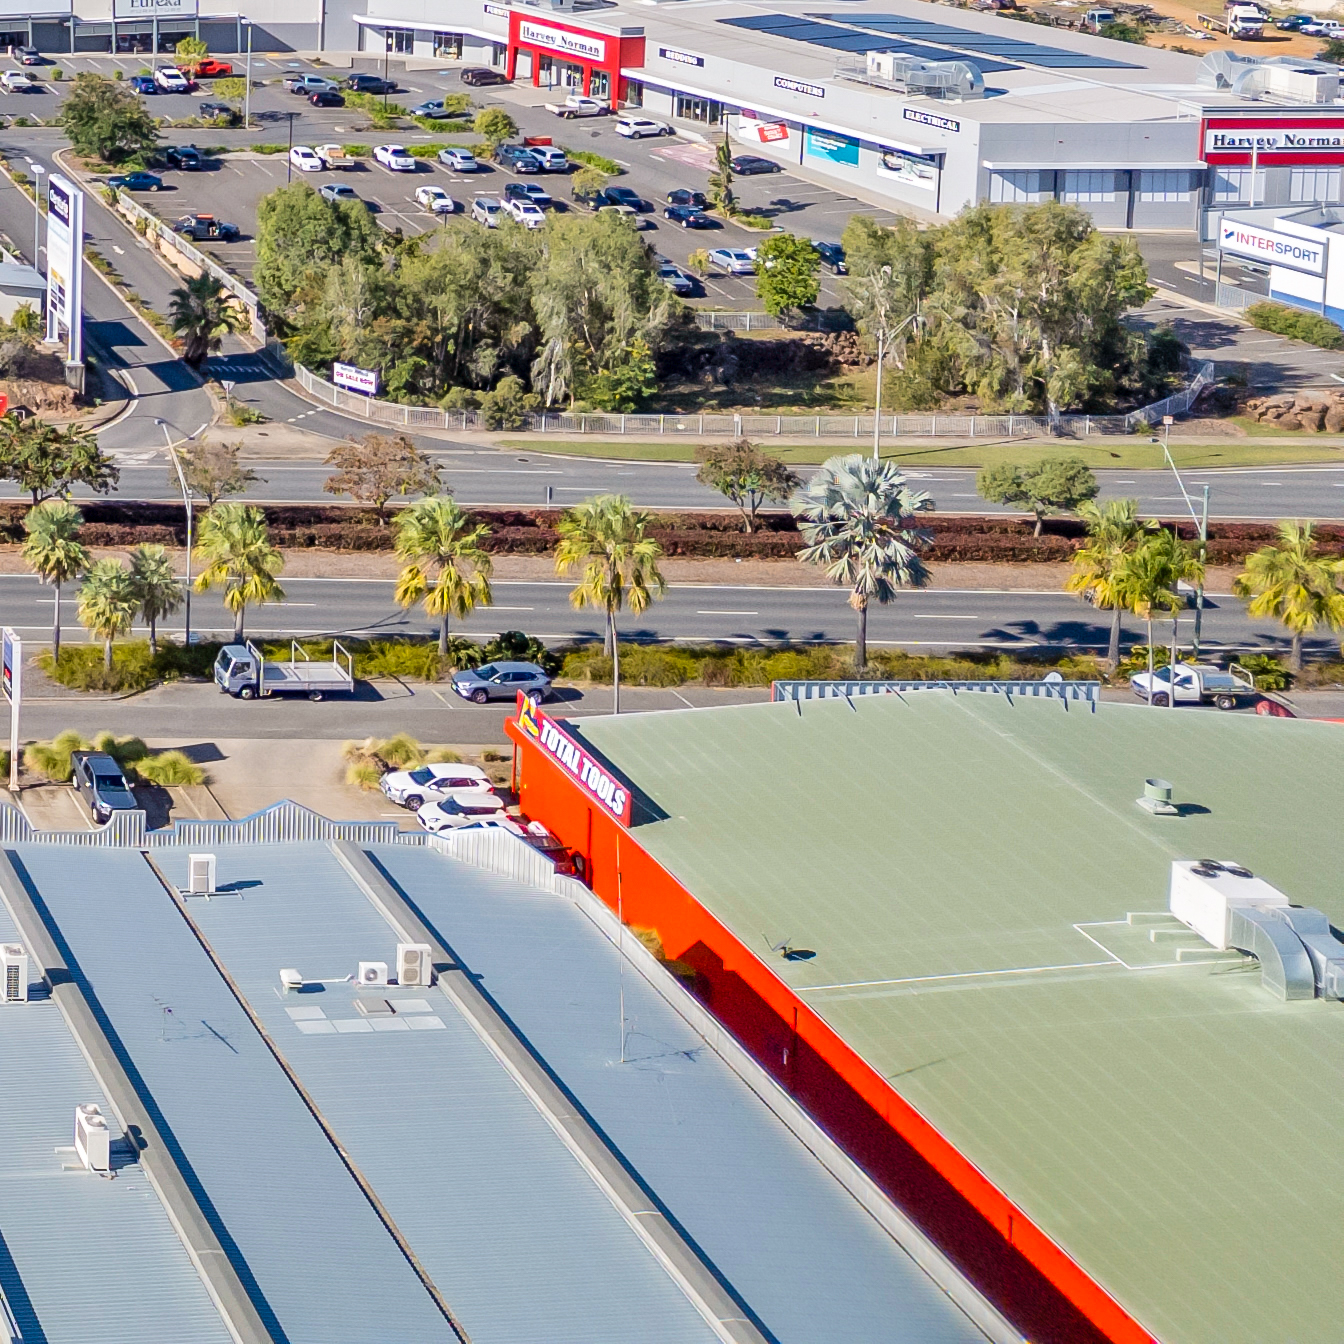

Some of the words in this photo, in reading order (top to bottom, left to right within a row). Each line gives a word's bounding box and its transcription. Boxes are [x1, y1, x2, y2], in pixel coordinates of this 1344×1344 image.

[522, 25, 556, 45] Harvey
[561, 35, 600, 55] Norman
[665, 50, 698, 65] BEDDING
[774, 77, 824, 97] COMPUTERS
[904, 110, 959, 131] ELECTRICAL
[1213, 134, 1278, 151] Harvey
[1283, 133, 1344, 146] Norma
[1236, 231, 1319, 263] INTERSPORT
[540, 719, 581, 775] TOTAL
[580, 756, 627, 816] TOOLS
